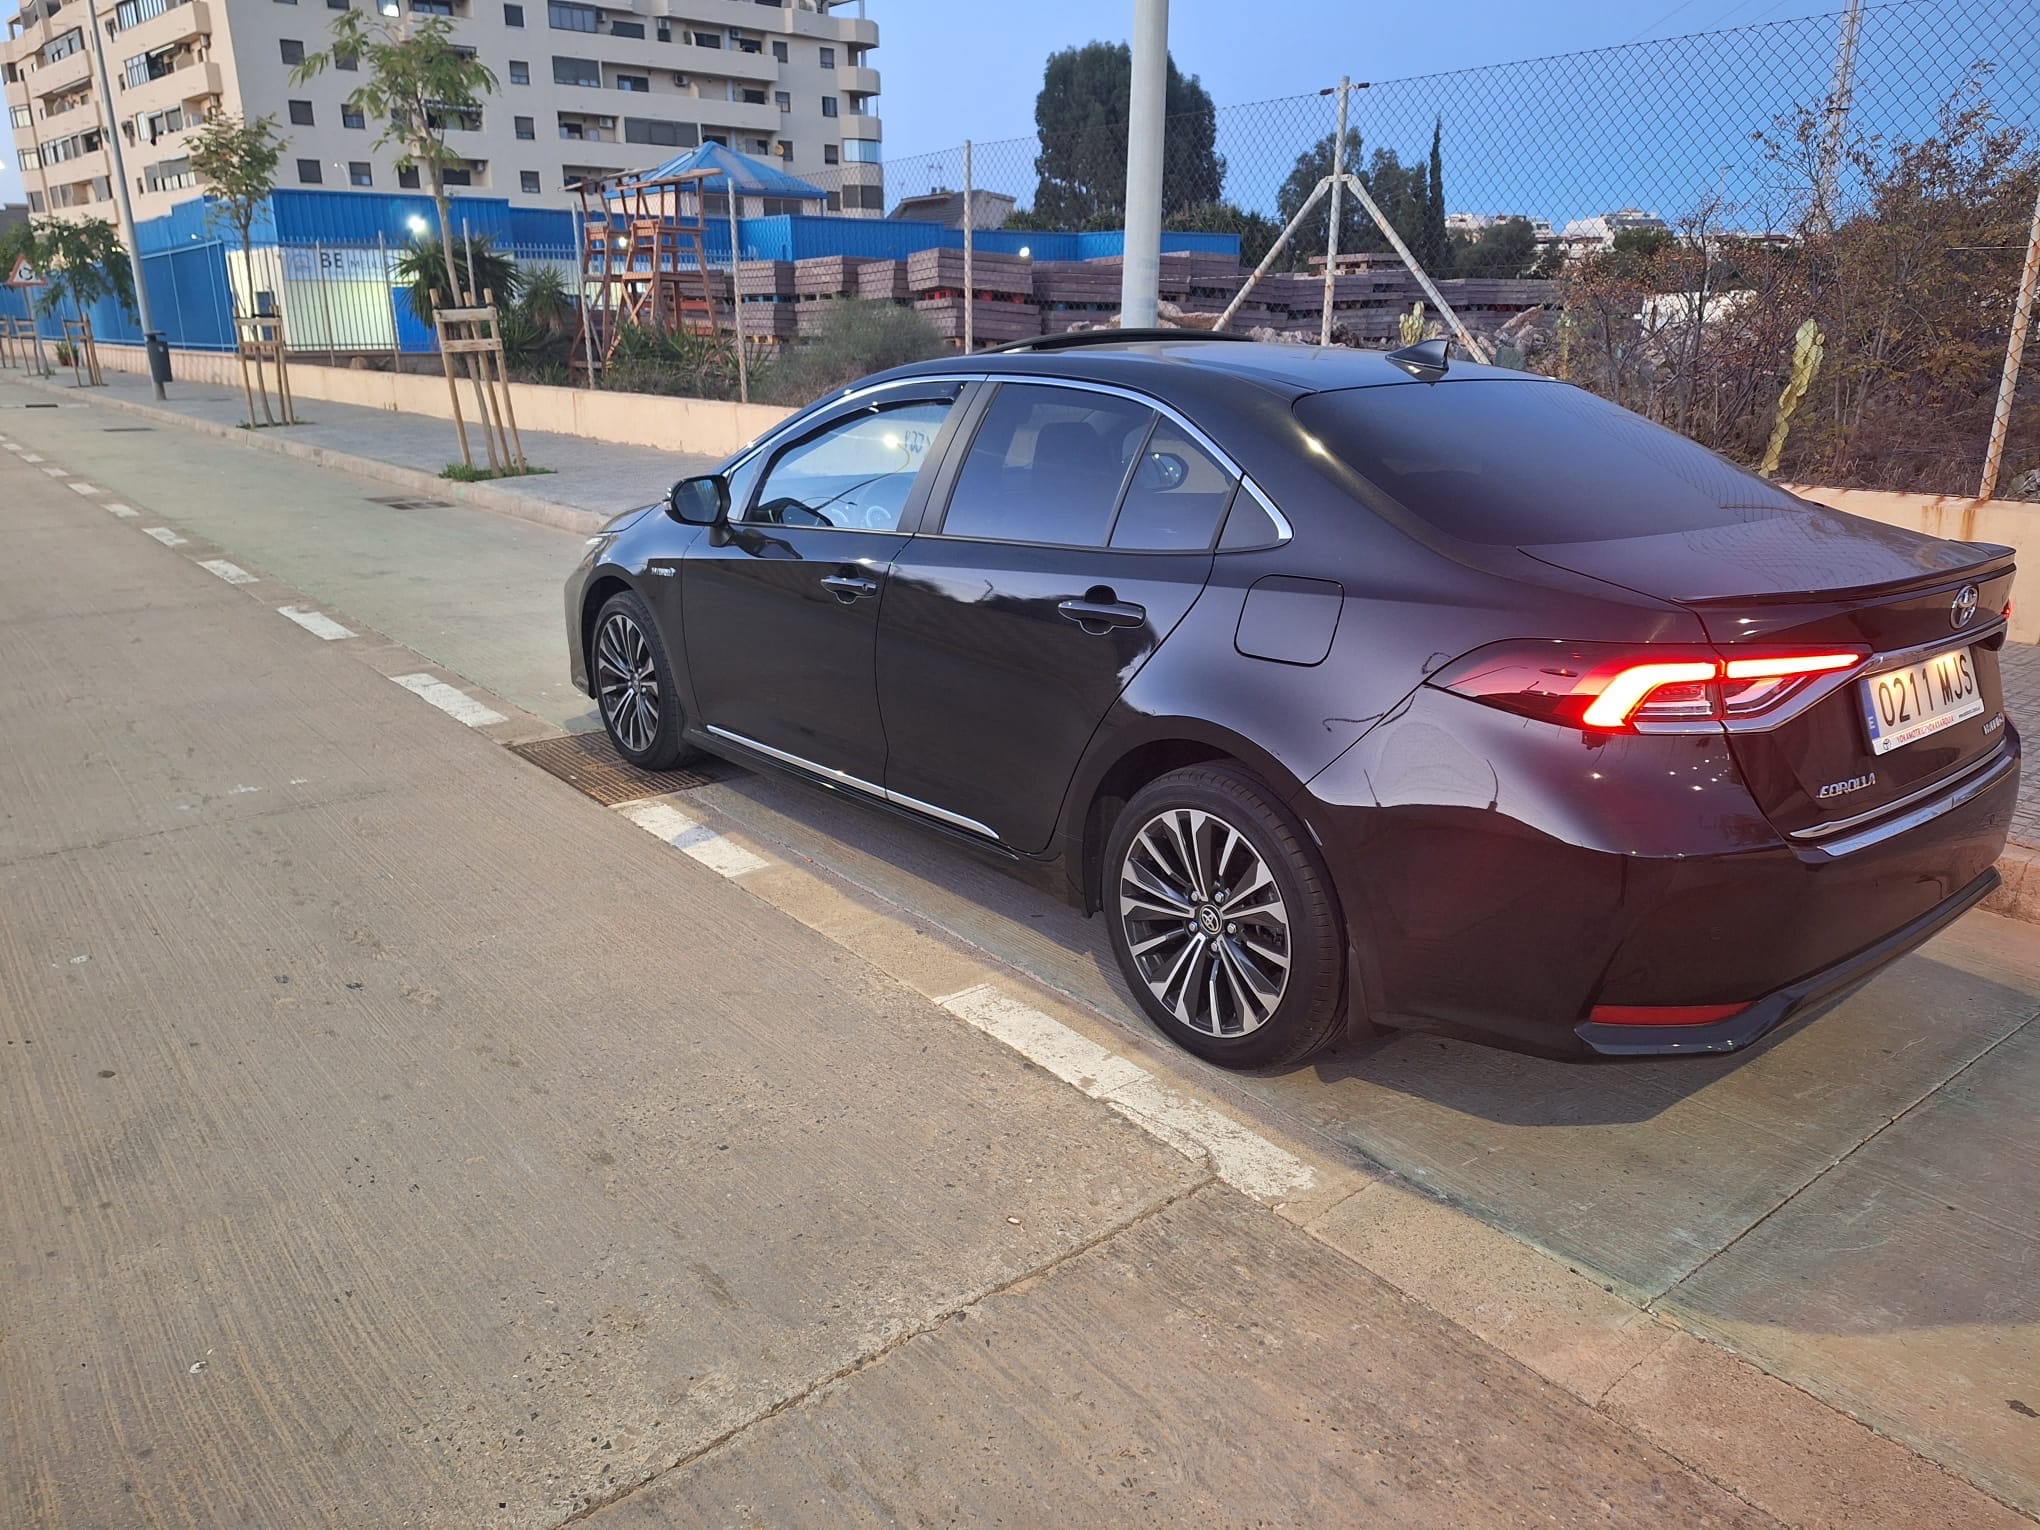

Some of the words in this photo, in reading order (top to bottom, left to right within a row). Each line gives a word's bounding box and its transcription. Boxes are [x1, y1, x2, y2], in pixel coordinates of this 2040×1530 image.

[320, 252, 344, 268] BE
[1879, 668, 1934, 727] 0211
[1936, 654, 1974, 706] MJS
[1868, 716, 1876, 730] E
[1817, 772, 1876, 799] COROLLA
